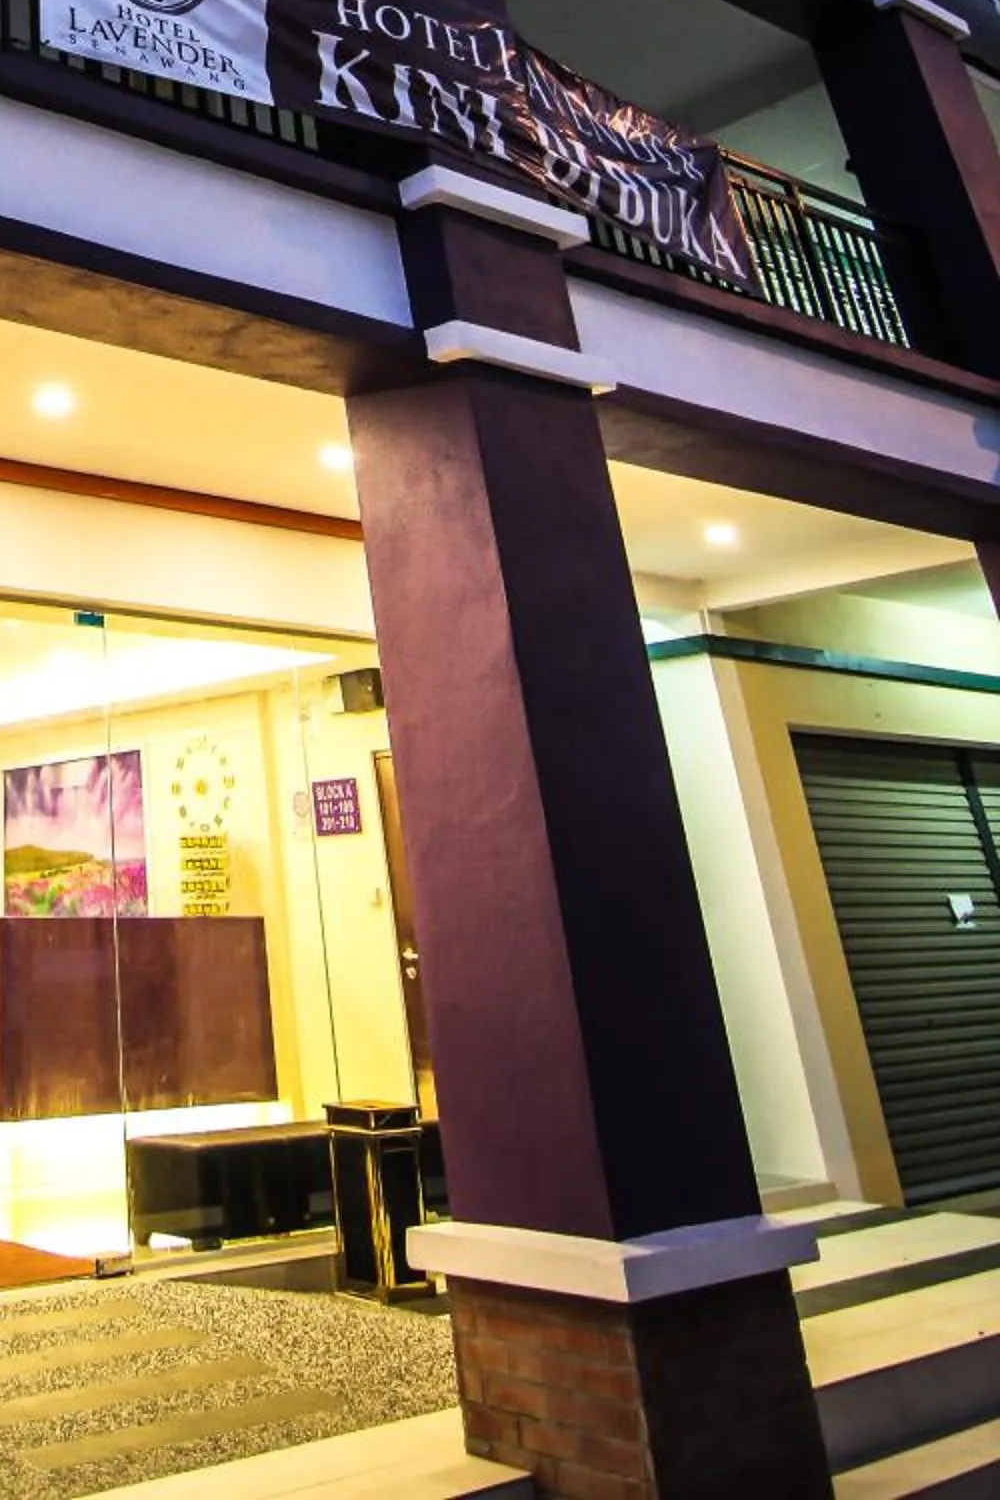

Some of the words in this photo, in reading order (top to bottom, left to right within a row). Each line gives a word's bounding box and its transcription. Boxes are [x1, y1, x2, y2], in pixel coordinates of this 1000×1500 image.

[68, 6, 240, 77] LAVENDER
[117, 3, 200, 43] HOTEL
[68, 33, 245, 92] SENAWANG
[311, 29, 514, 162] KINI
